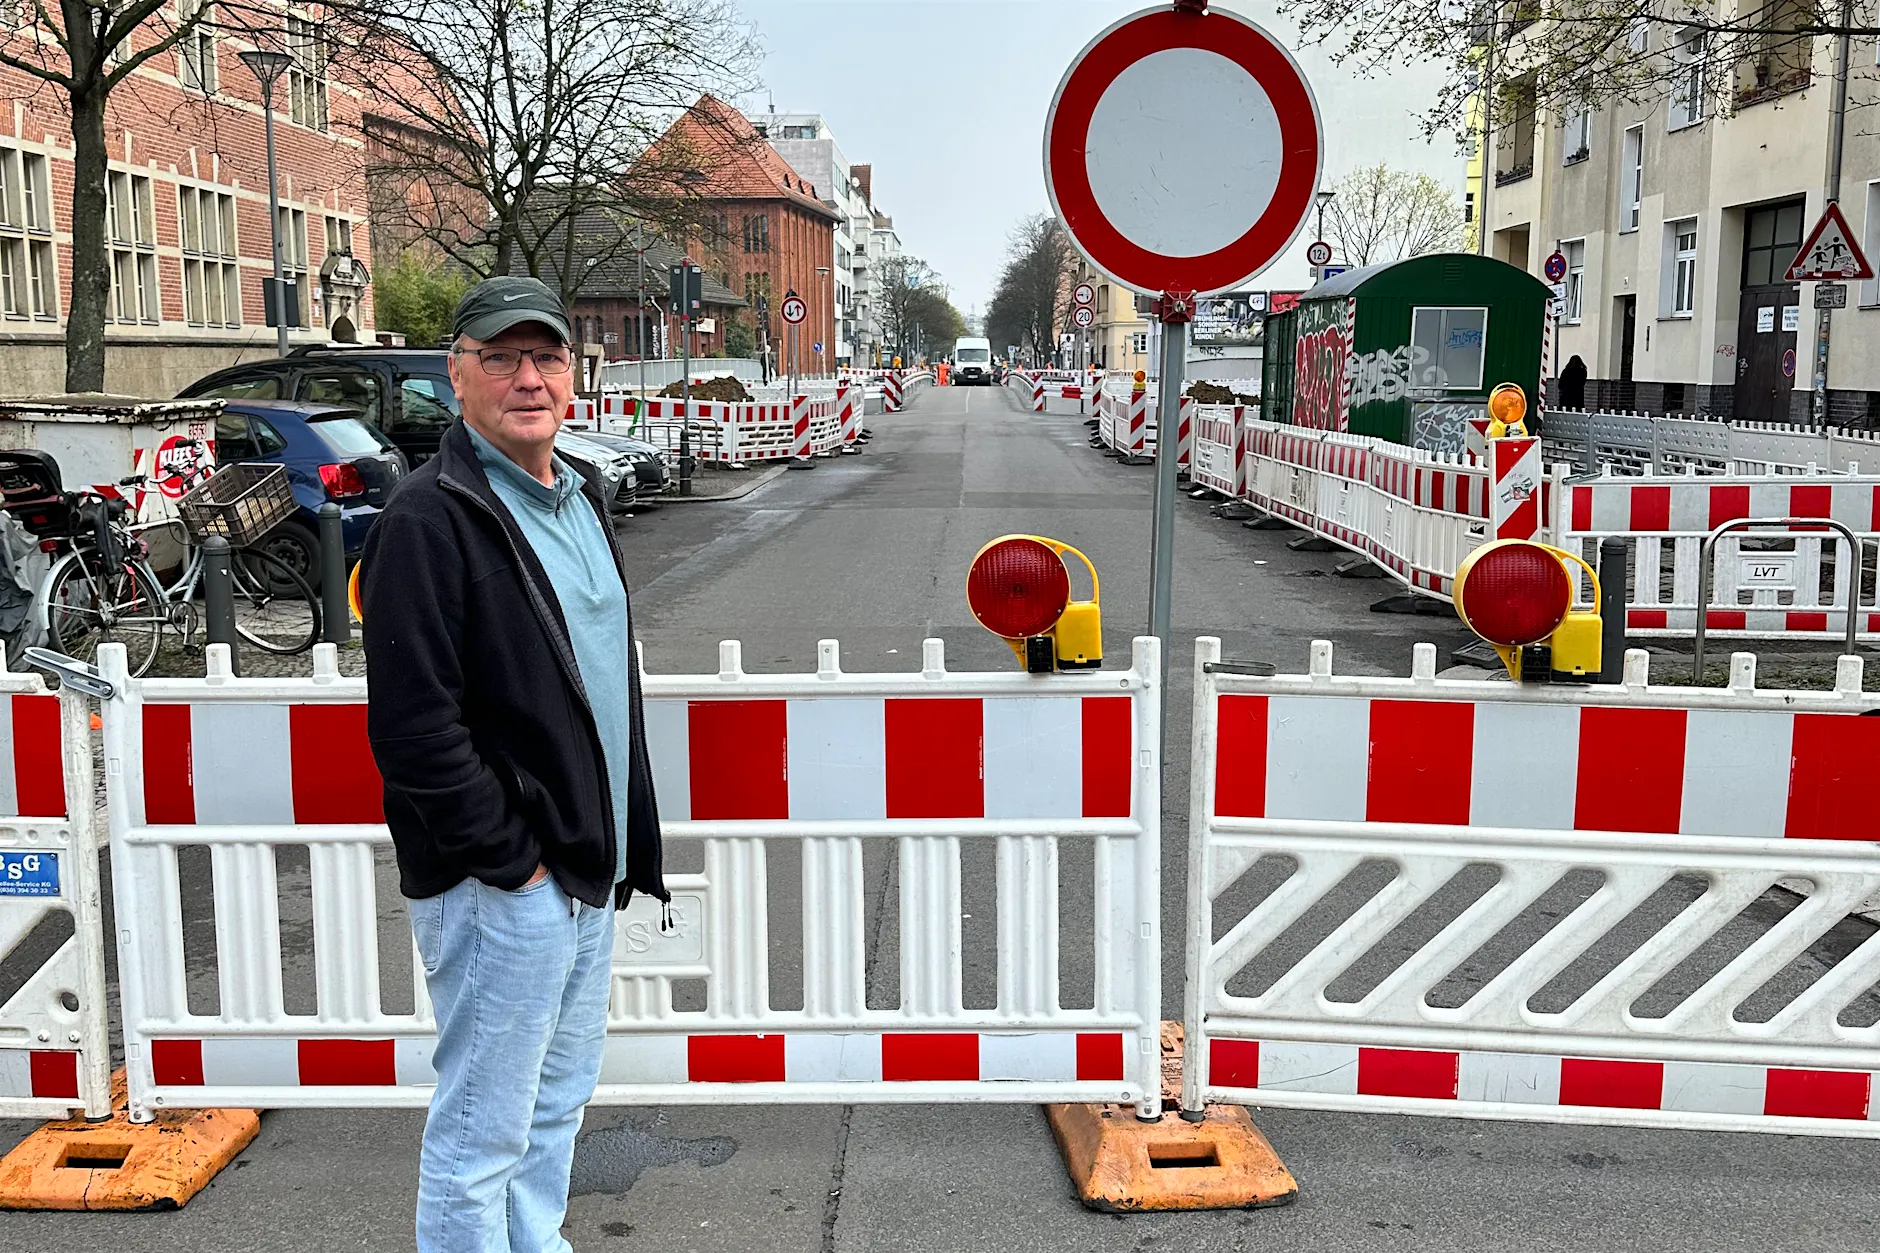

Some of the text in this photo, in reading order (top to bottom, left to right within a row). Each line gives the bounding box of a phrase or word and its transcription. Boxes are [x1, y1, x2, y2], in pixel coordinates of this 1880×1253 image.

[1078, 311, 1090, 322] 20
[189, 424, 207, 440] 3563
[1754, 567, 1779, 577] LVT
[614, 906, 688, 953] SG
